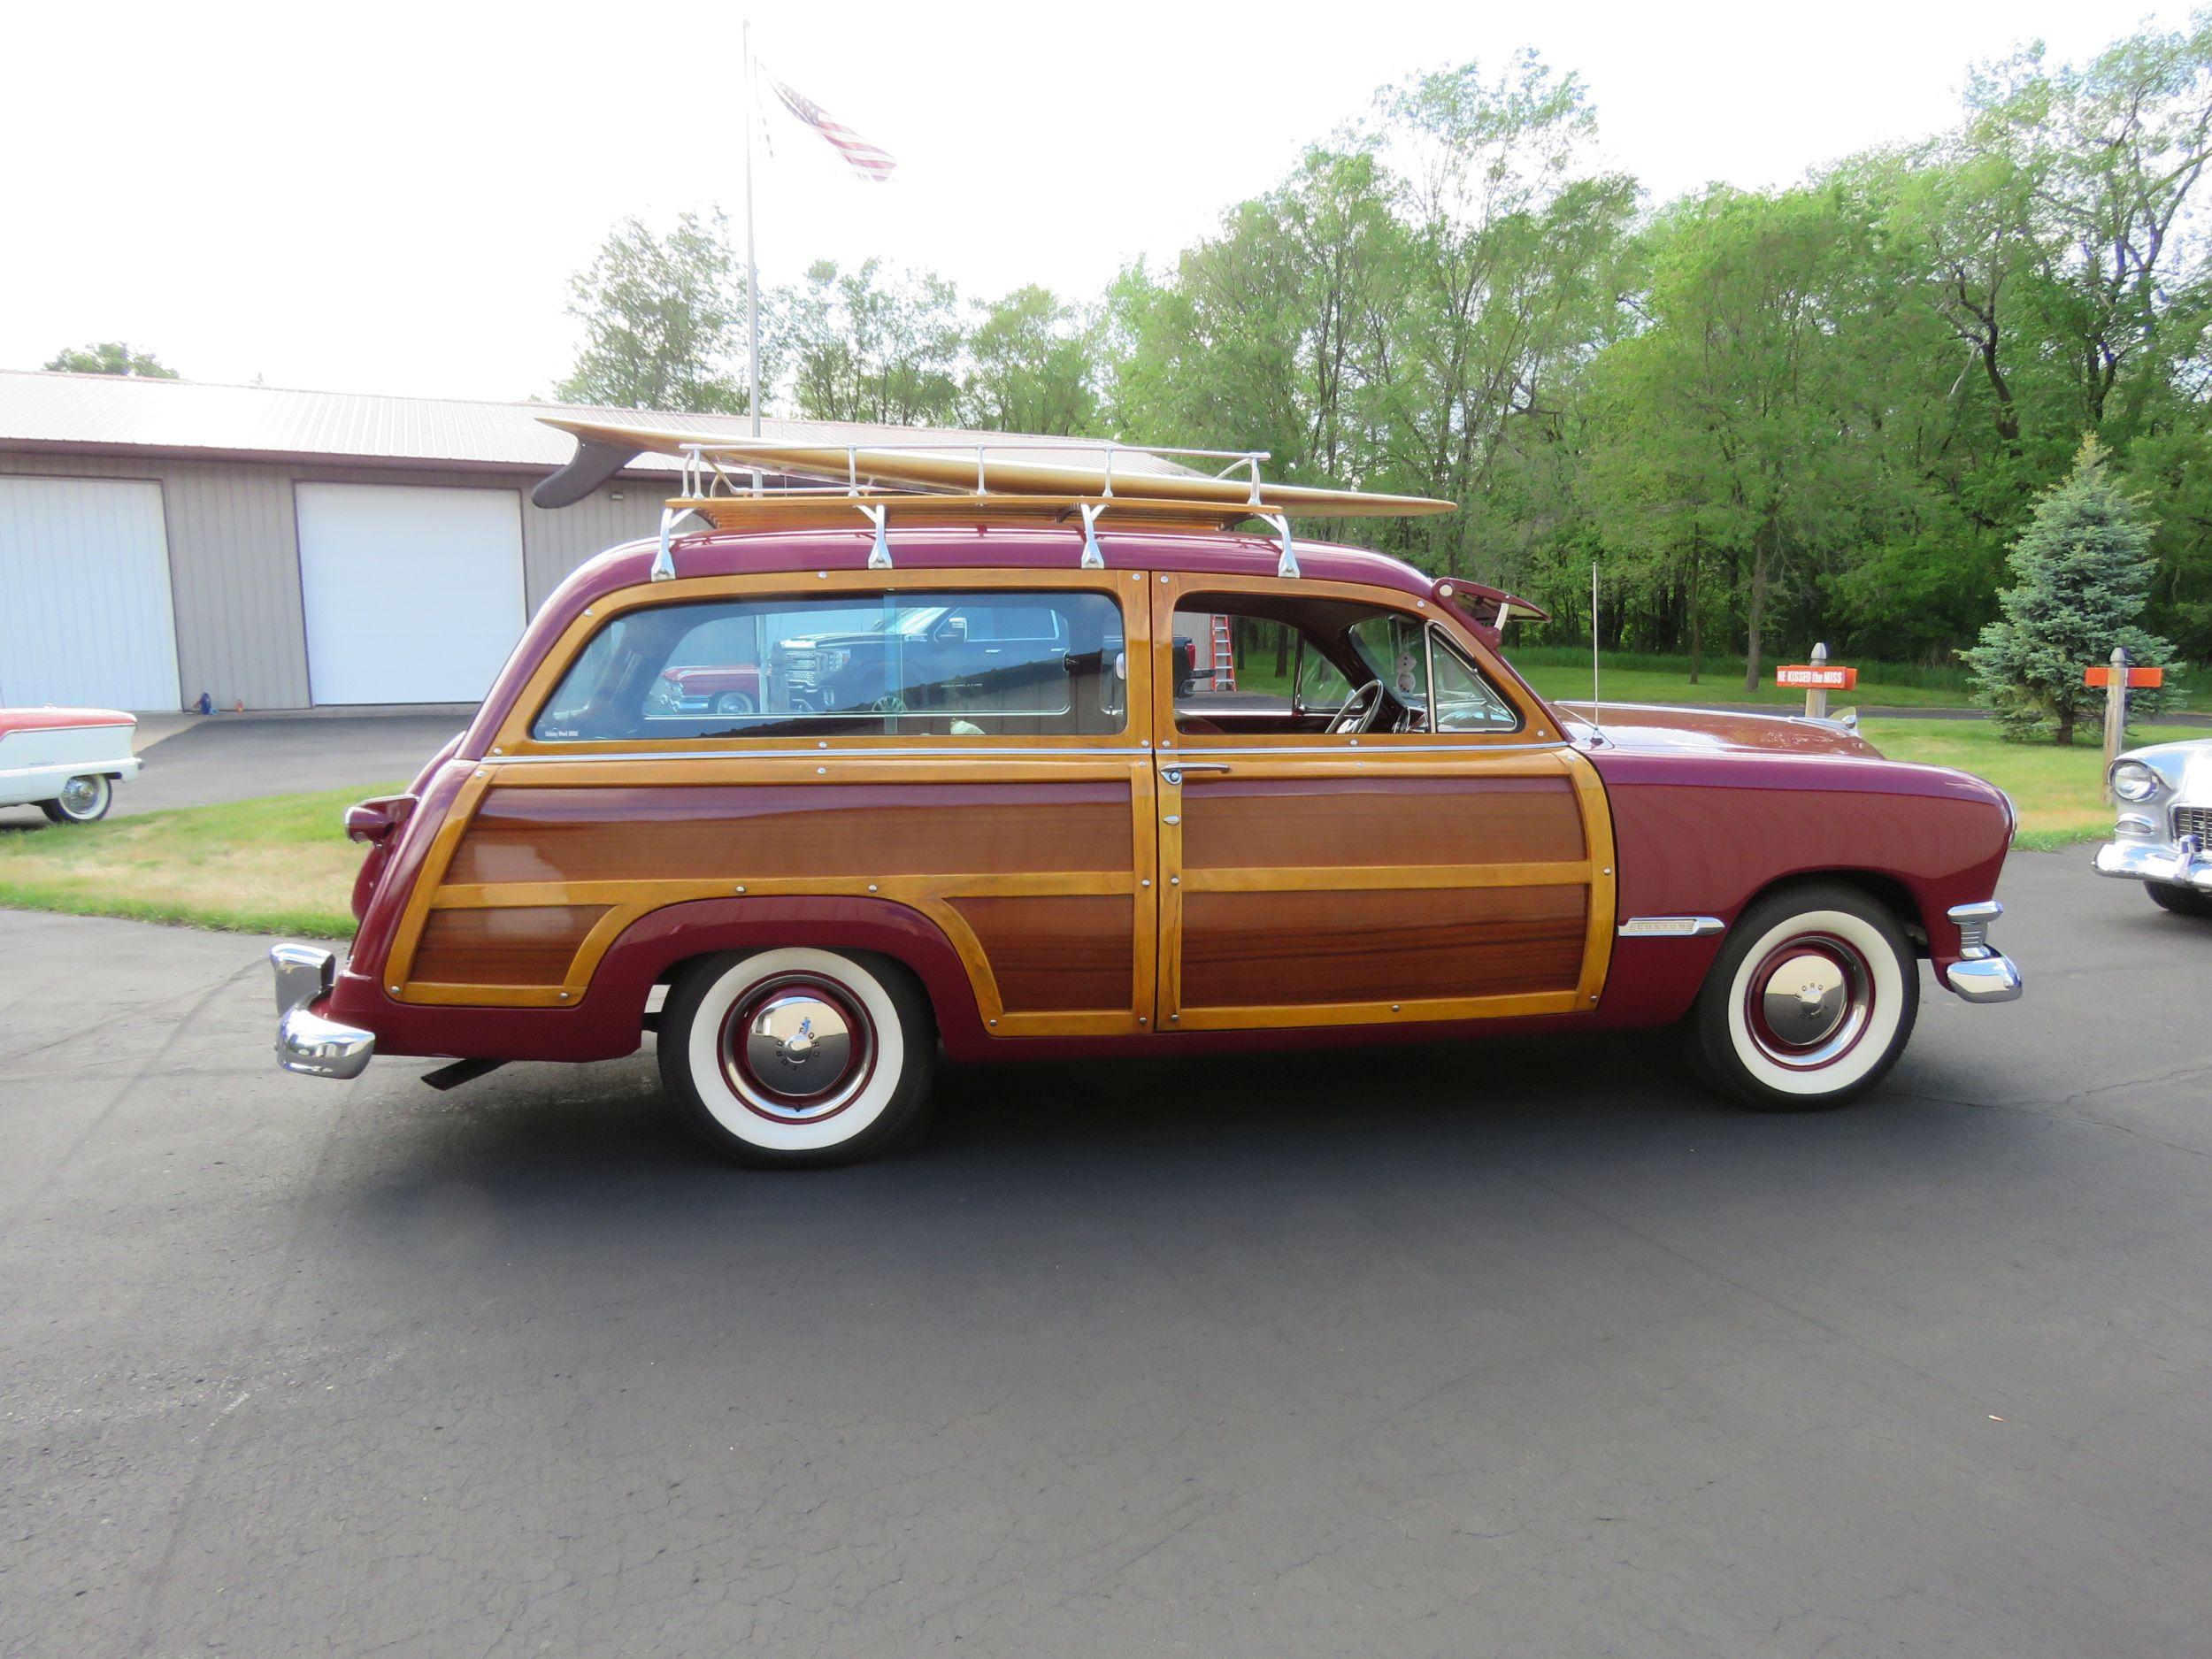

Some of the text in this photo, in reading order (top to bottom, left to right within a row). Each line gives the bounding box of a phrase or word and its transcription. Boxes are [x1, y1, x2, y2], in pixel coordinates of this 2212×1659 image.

[1778, 671, 1842, 683] HE KISSED the MISS
